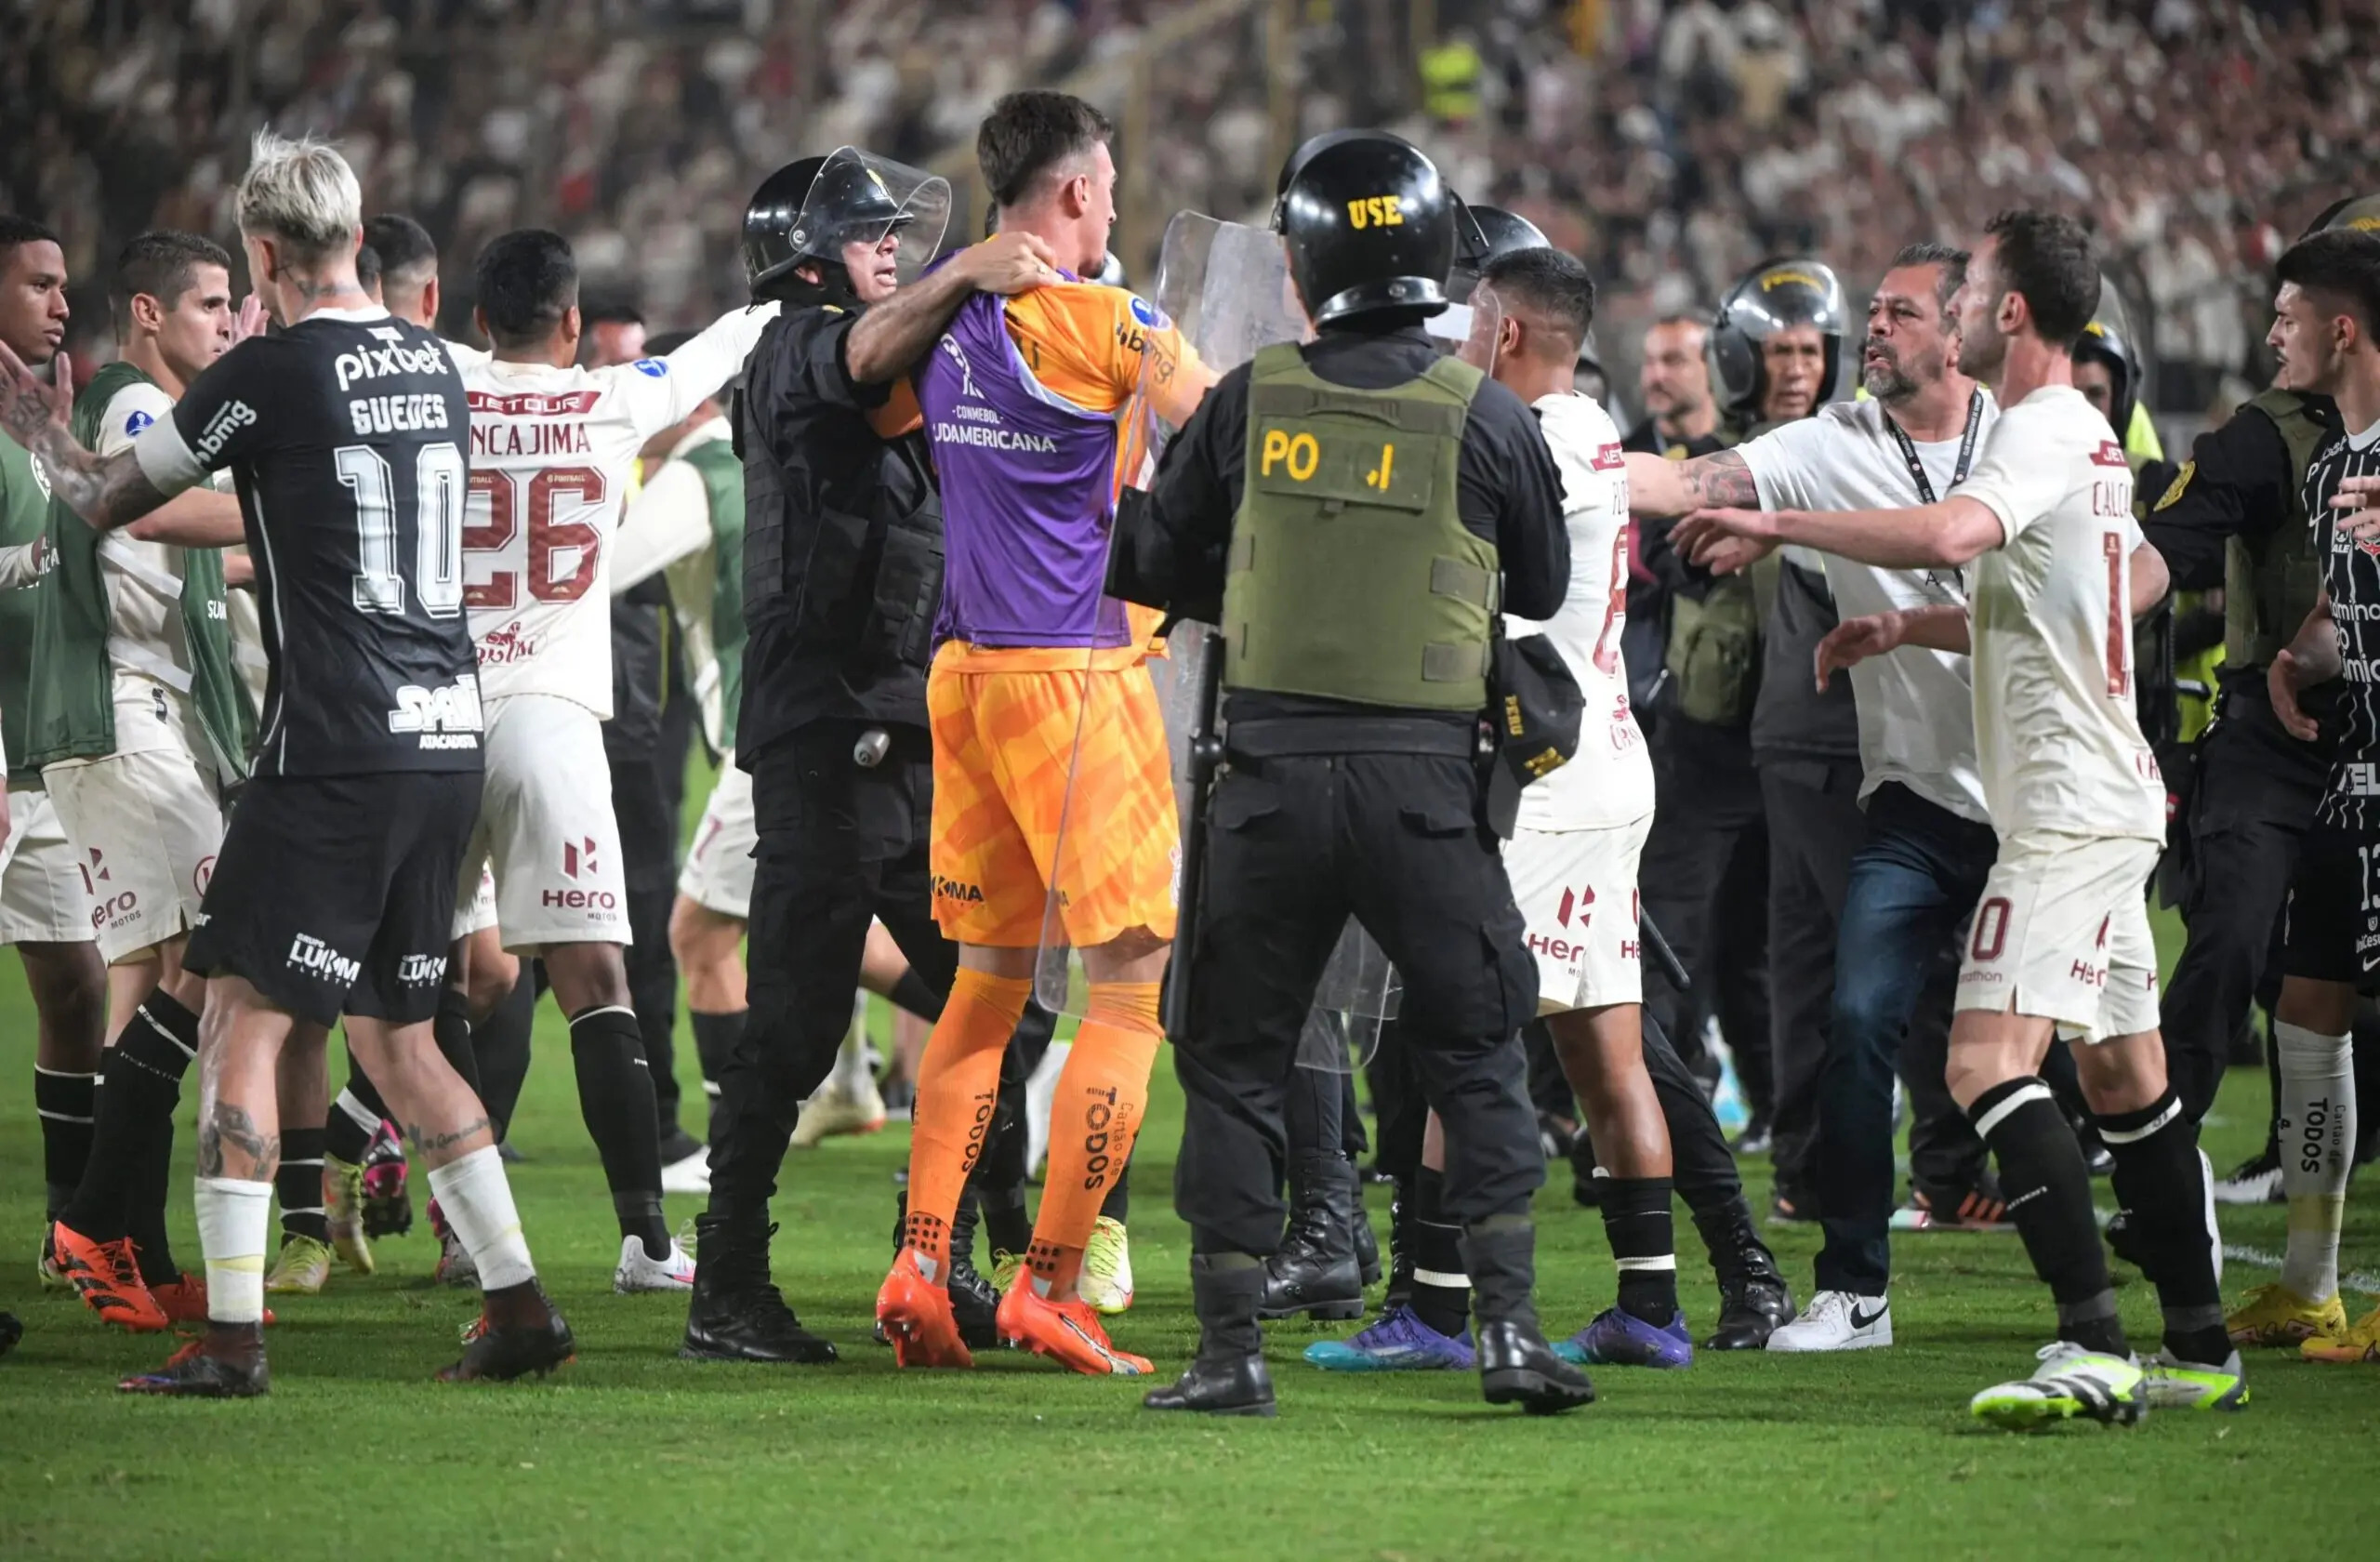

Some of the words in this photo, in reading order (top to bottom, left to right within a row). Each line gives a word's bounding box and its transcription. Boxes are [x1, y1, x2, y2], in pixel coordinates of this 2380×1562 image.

[1348, 195, 1403, 229] USE
[335, 339, 448, 391] pixbet
[197, 400, 257, 455] bmg
[350, 393, 448, 435] GUEDES
[334, 443, 465, 619] 10
[462, 466, 606, 609] 26
[111, 910, 141, 930] MOTOS
[543, 890, 615, 908] Hero
[588, 912, 617, 920] MOTOS
[961, 1088, 994, 1172] TODOS
[1084, 1086, 1117, 1191] TODOS
[2300, 1097, 2328, 1173] TODOS
[2332, 1104, 2347, 1145] Cartão
